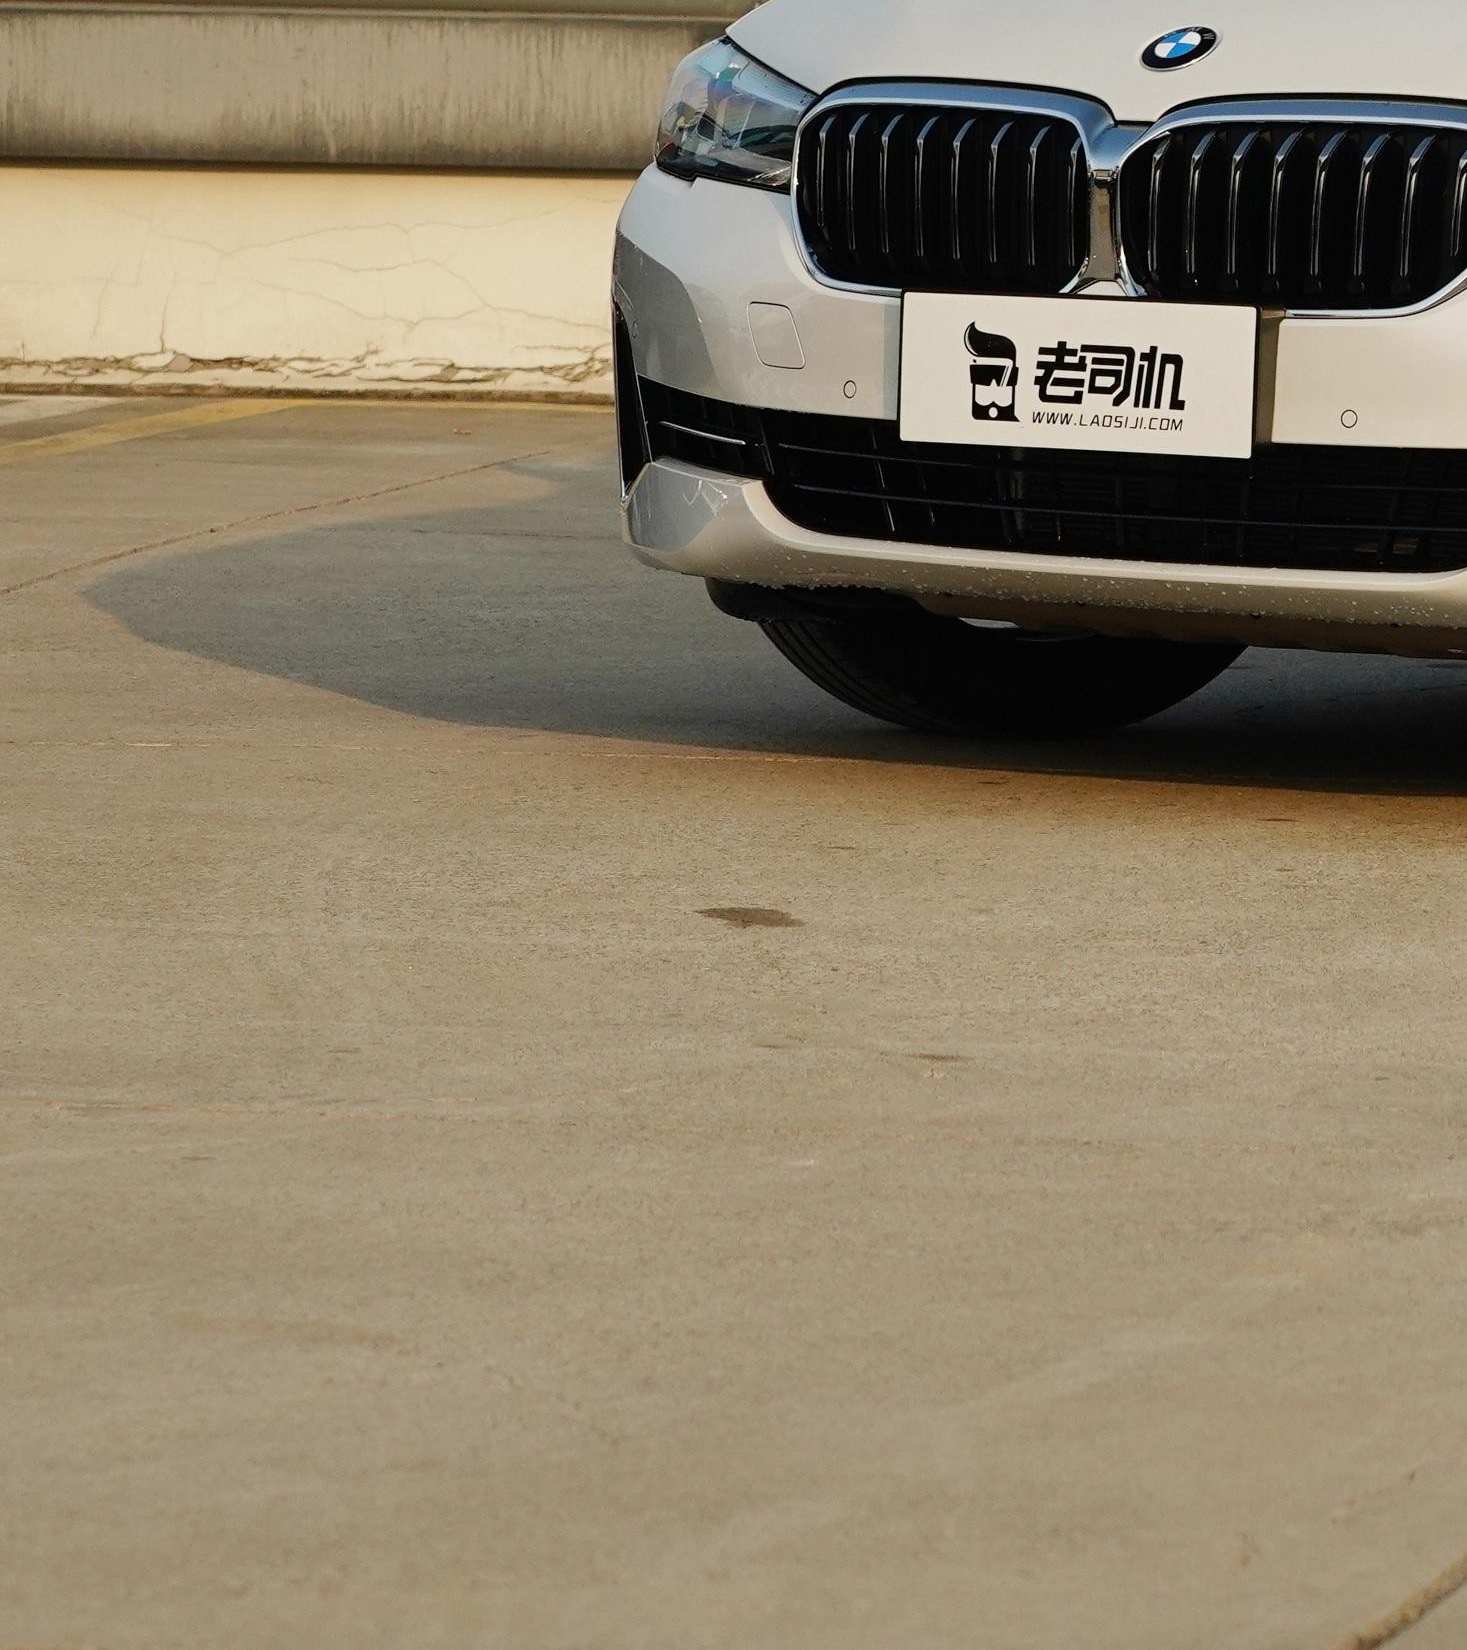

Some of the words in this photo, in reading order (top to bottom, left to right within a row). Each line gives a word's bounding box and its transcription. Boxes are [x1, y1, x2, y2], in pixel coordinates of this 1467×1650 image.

[1034, 341, 1185, 410] 老司机
[1032, 411, 1184, 431] WWW.LAOSIJI.COM
